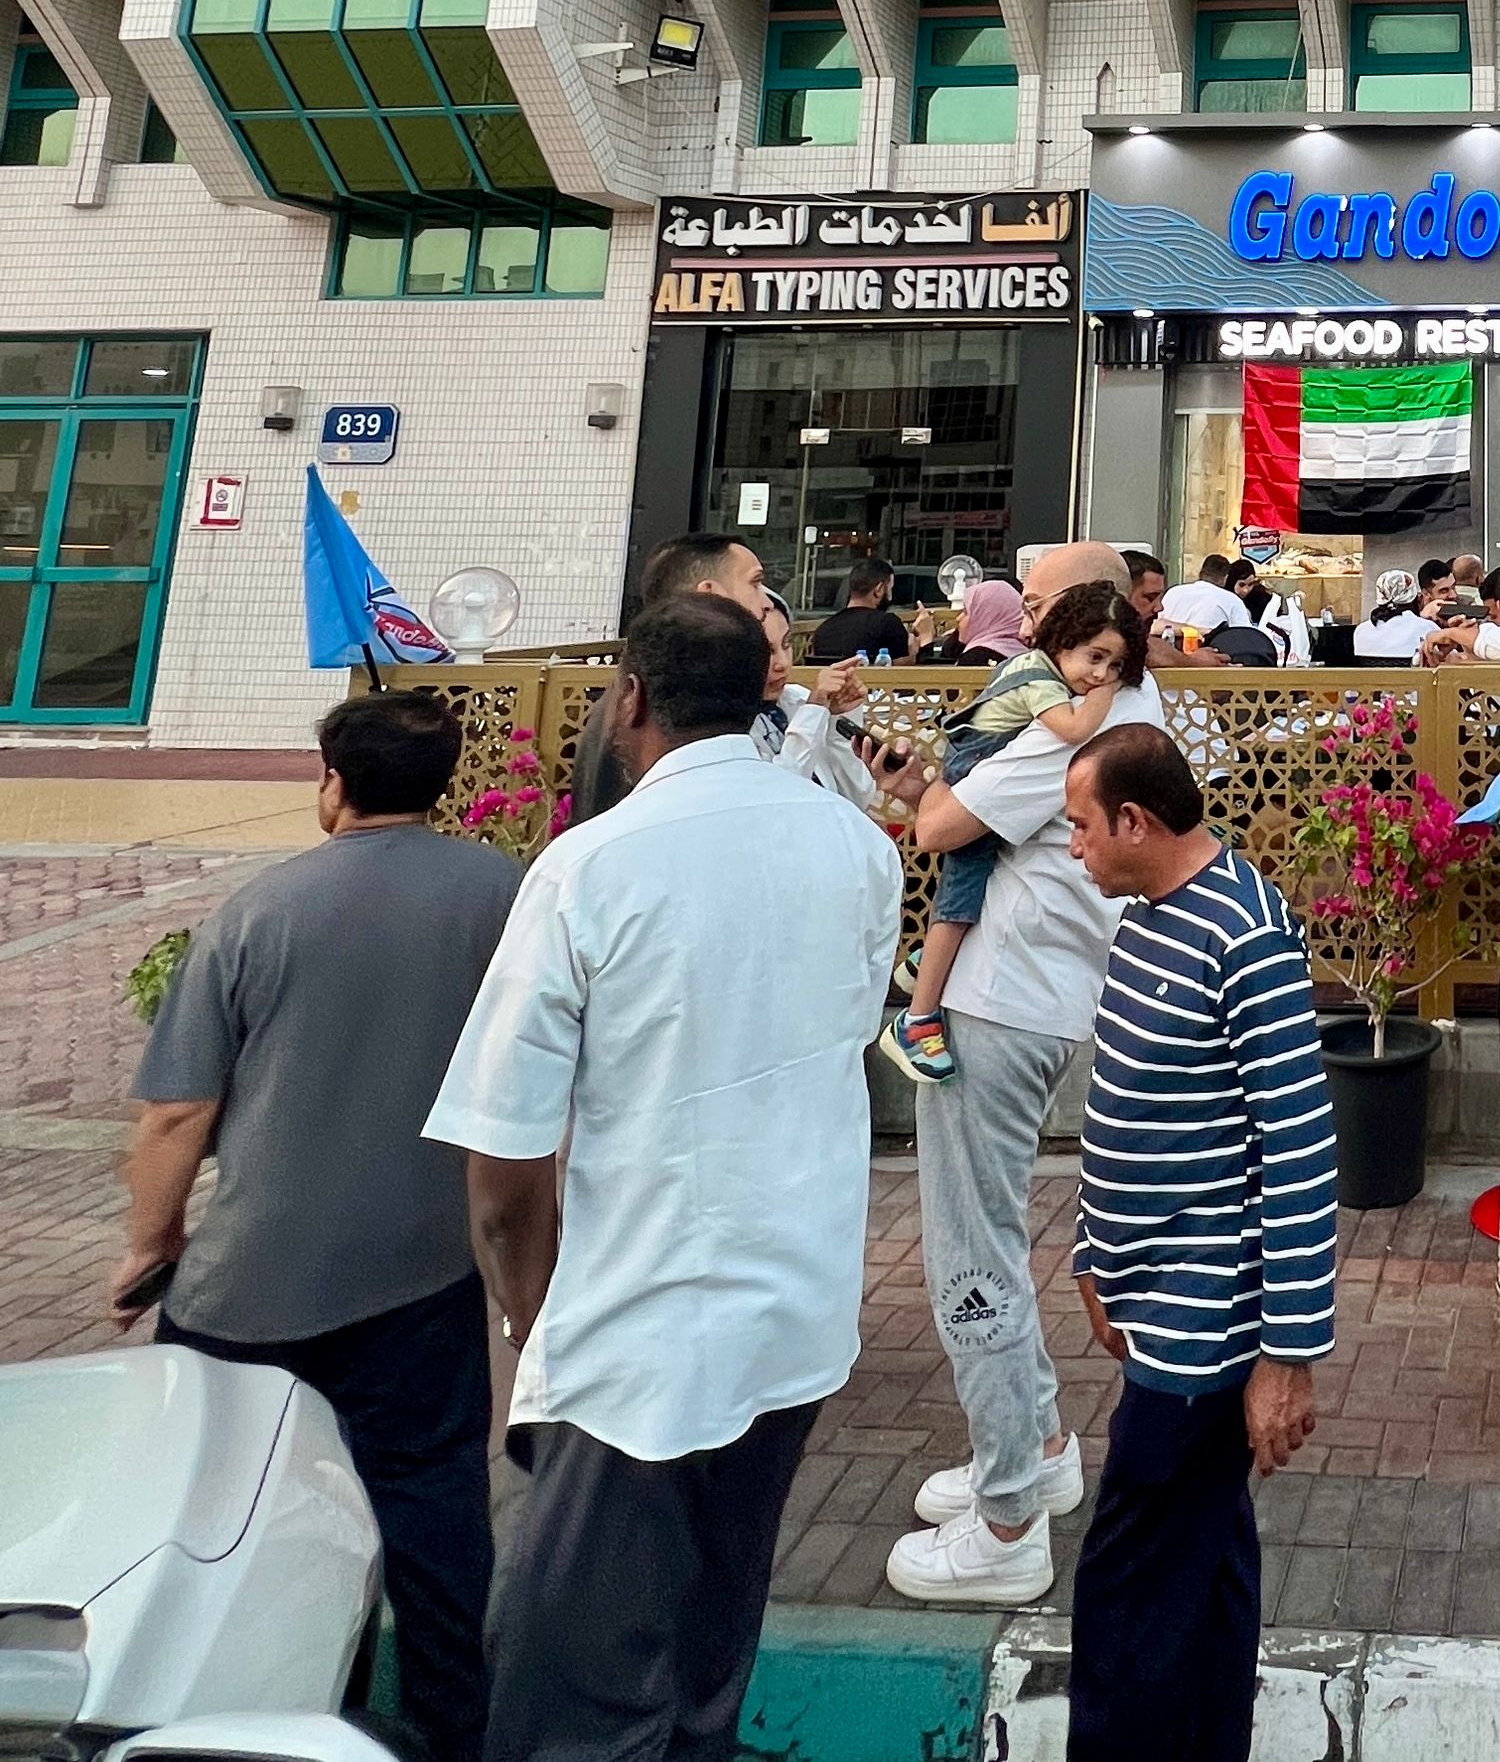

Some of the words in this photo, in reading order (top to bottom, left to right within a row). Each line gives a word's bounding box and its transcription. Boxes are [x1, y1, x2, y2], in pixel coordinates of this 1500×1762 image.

[662, 203, 809, 256] الطباعة
[818, 200, 972, 246] لخدمات
[654, 272, 743, 313] ALFA
[752, 269, 883, 312] TYPING
[891, 266, 1070, 310] SERVICES
[1219, 319, 1403, 358] SEAFOOD
[336, 413, 382, 436] 839
[950, 1306, 997, 1324] adidas
